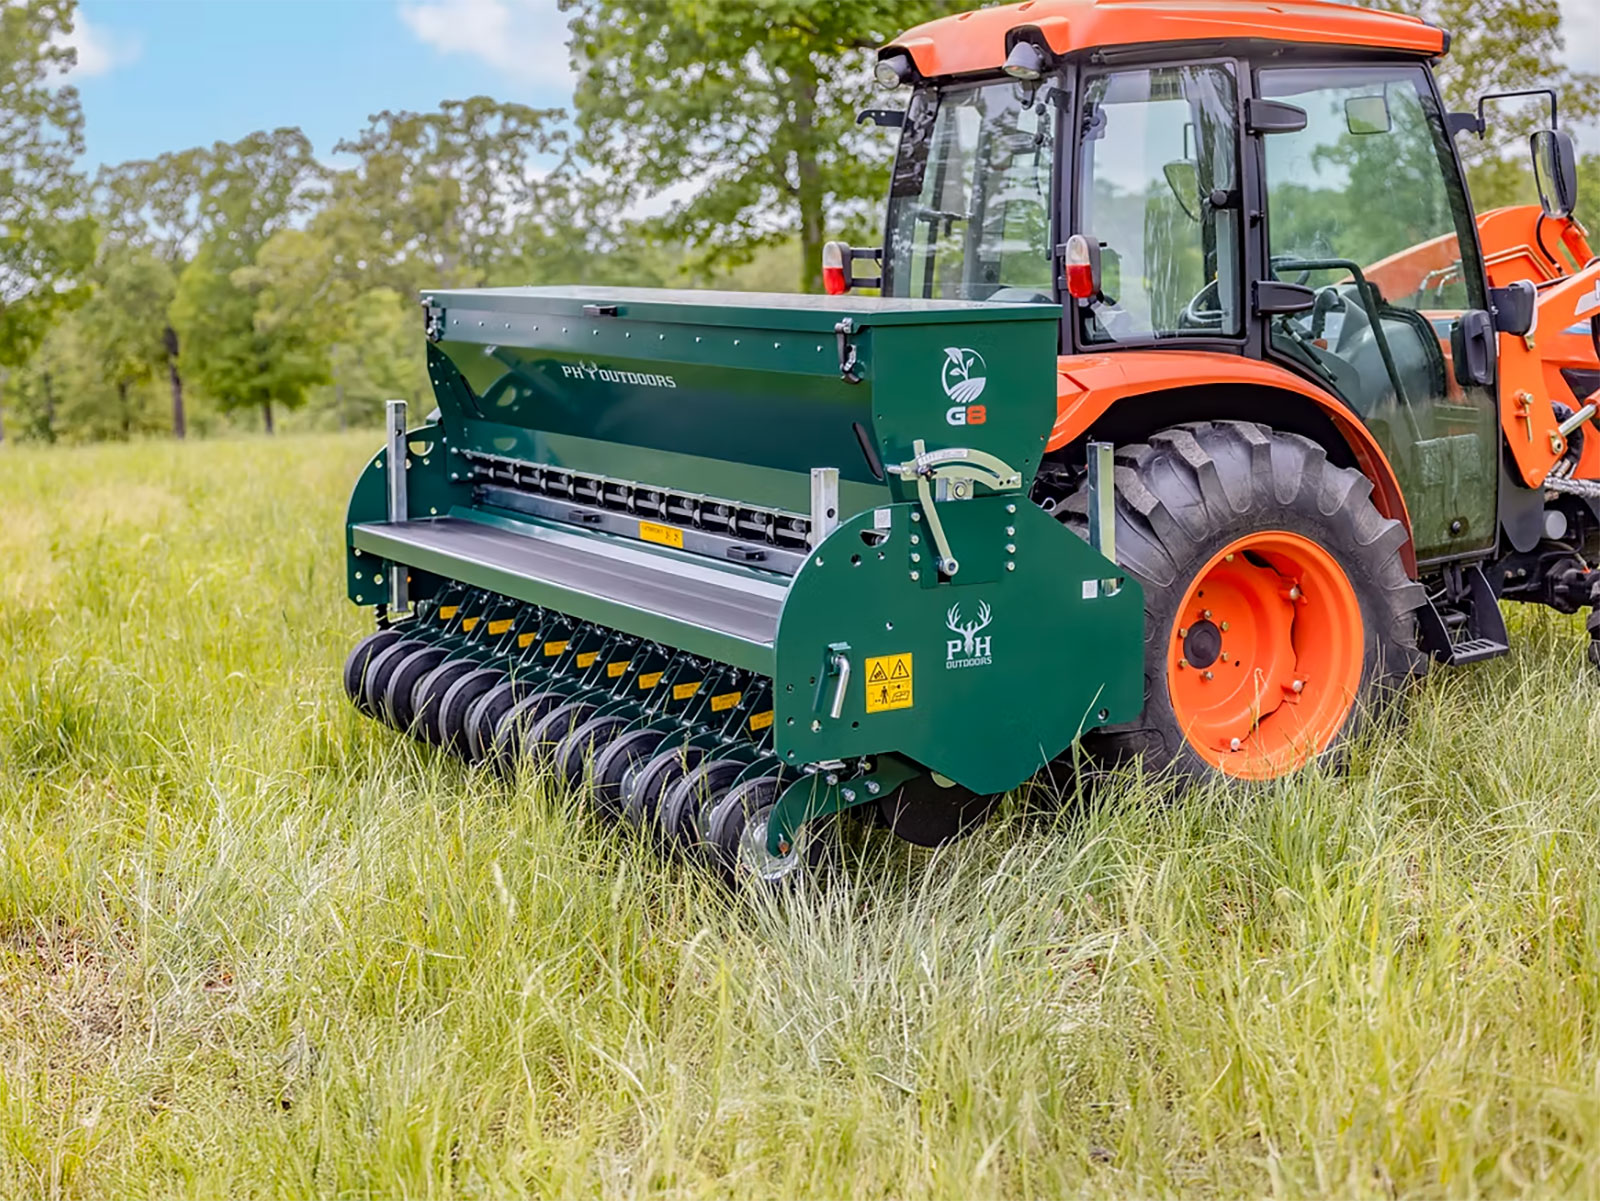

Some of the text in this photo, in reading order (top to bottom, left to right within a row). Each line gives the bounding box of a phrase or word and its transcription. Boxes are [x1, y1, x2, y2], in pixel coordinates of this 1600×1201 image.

[561, 365, 677, 389] PH OUTDOORS
[946, 405, 987, 426] G8
[945, 656, 993, 670] OUTDOORS
